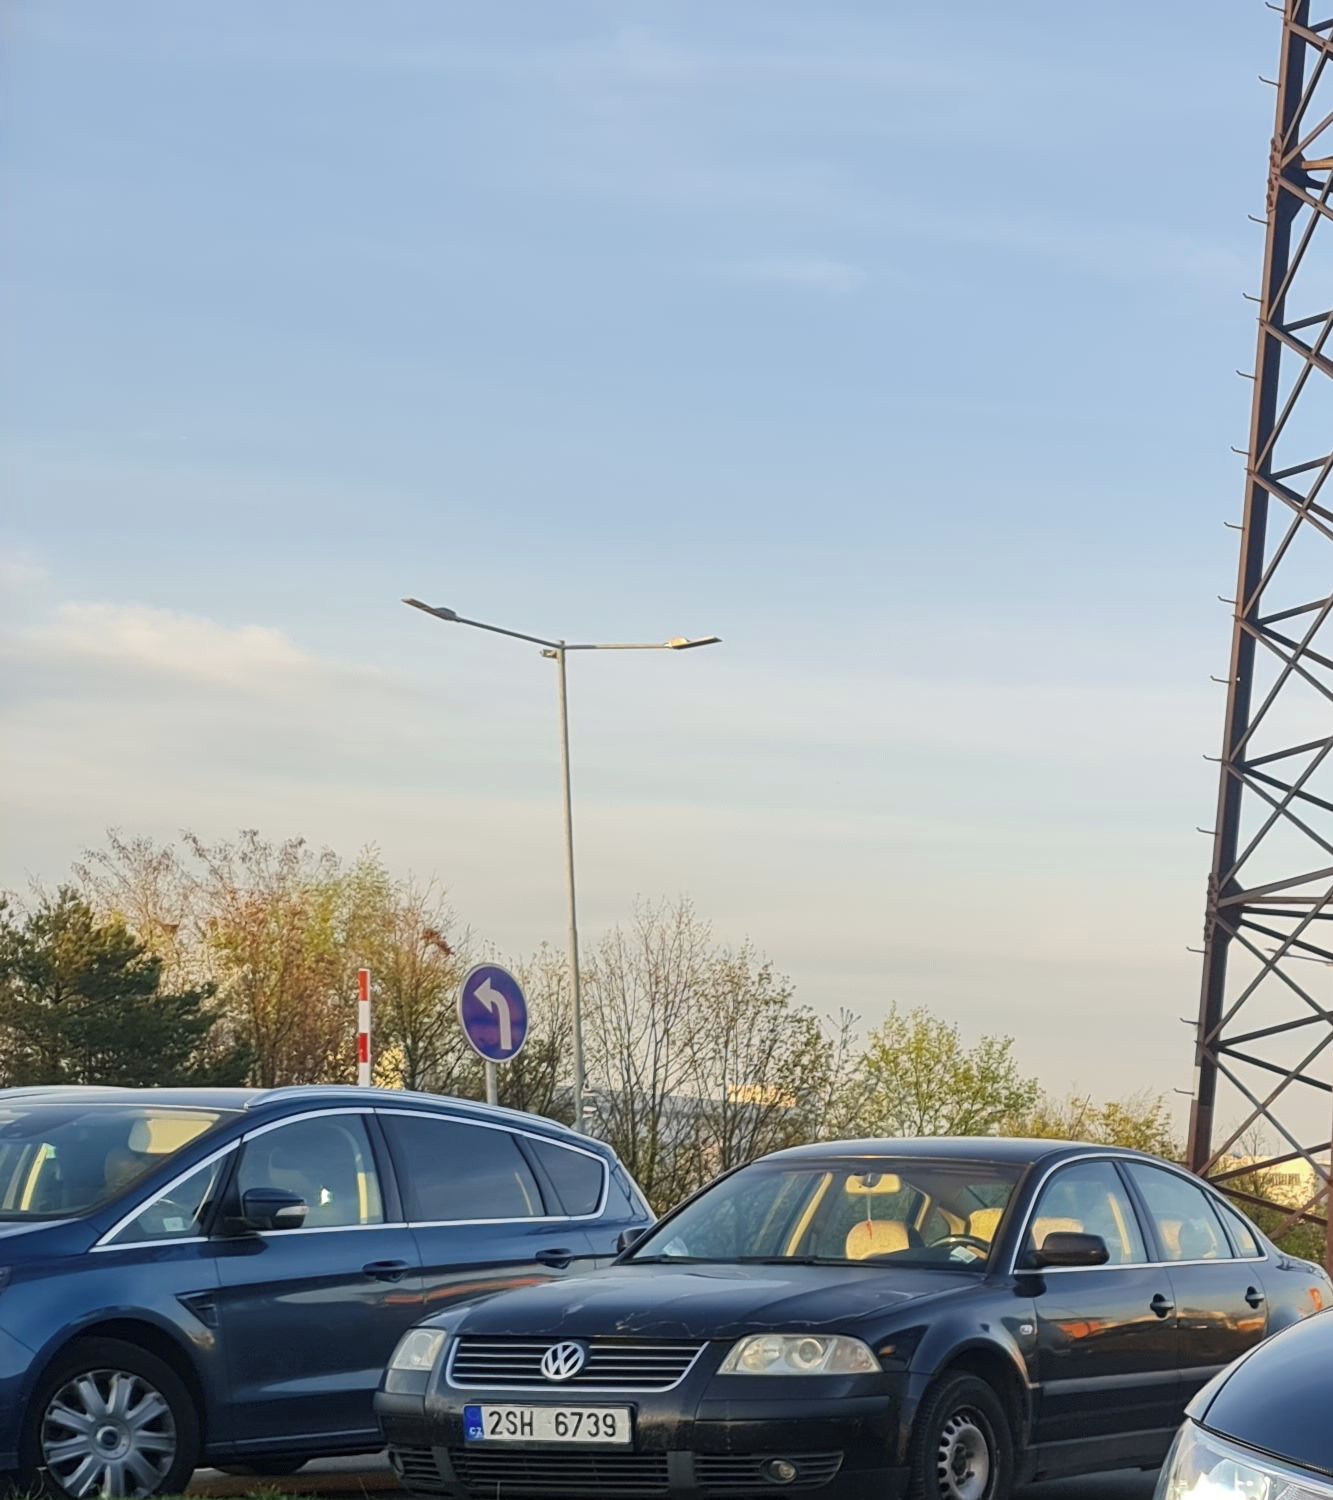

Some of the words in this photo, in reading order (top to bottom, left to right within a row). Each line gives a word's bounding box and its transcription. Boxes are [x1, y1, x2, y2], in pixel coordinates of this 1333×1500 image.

[469, 1426, 484, 1439] CZ
[488, 1410, 534, 1437] 2SH
[554, 1411, 616, 1438] 6739
